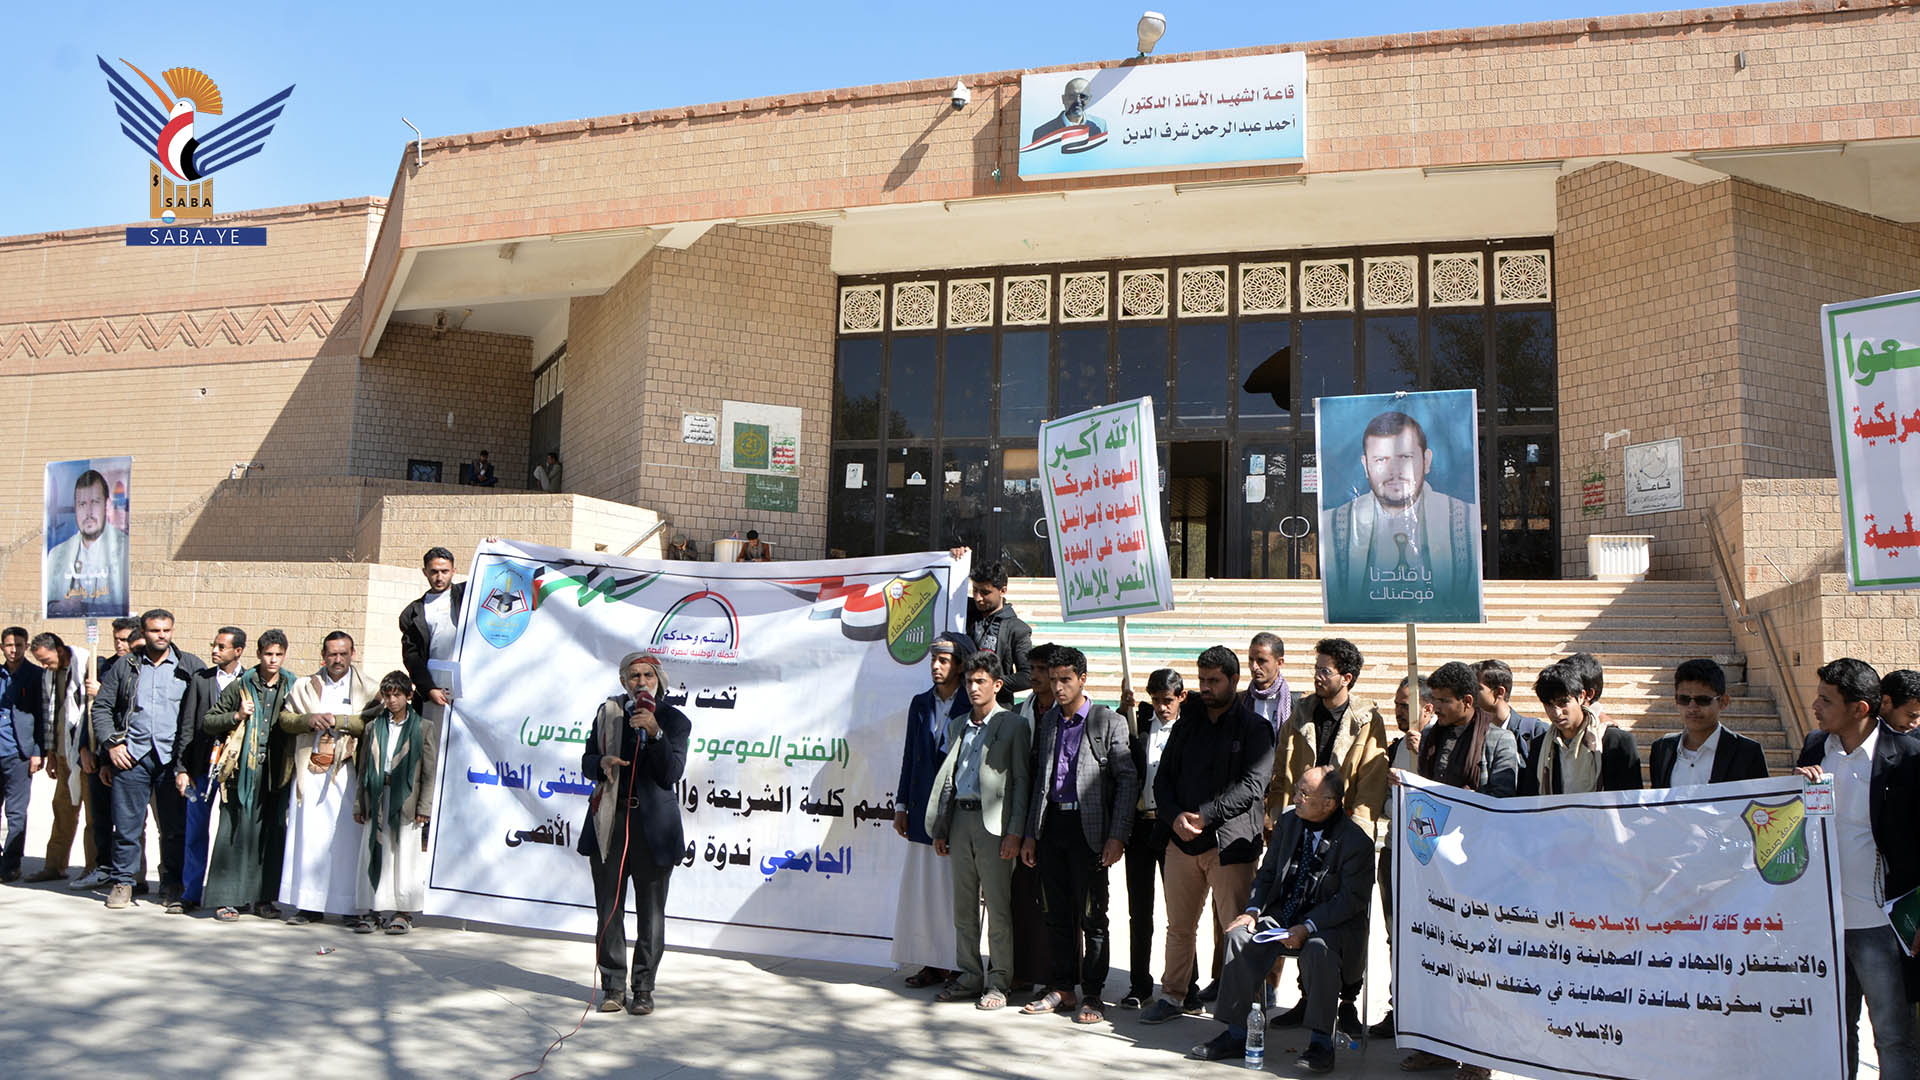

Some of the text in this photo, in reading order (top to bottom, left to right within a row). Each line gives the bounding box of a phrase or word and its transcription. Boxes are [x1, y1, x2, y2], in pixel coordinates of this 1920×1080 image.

[1175, 90, 1213, 108] الأستاذ
[1217, 88, 1259, 106] الشهيد
[1263, 84, 1295, 100] قاعة
[1122, 123, 1157, 145] الدين
[1161, 121, 1190, 140] شرف
[1264, 113, 1296, 131] أحمد
[1048, 417, 1102, 471] أكبر
[1052, 459, 1138, 498] الموت لأمريكا
[1636, 477, 1671, 492] قاعة
[1105, 493, 1142, 524] الموت
[1064, 537, 1094, 567] اليهود
[1117, 529, 1146, 553] اللعنة
[1114, 559, 1151, 601] النصر
[1420, 565, 1432, 585] يا
[1369, 586, 1435, 604] فوضناك
[660, 630, 729, 646] لستم وحدكم
[695, 685, 738, 710] تحت
[693, 735, 782, 764] الموعود
[466, 761, 532, 791] الطالب
[706, 779, 792, 818] الشريعة
[799, 786, 846, 823] كلية
[853, 792, 896, 829] قيم
[505, 813, 571, 849] الأقصى
[704, 835, 752, 871] ندوة
[759, 844, 852, 883] الجامعي
[1460, 900, 1489, 919] لجان
[1494, 904, 1540, 924] تشكيل
[1545, 910, 1565, 932] إلى
[1569, 911, 1640, 935] الإسلامية
[1645, 913, 1709, 934] الشعوب
[1712, 913, 1740, 931] كافة
[1742, 912, 1785, 934] ندعو
[1506, 939, 1572, 965] والأهداف
[1576, 945, 1643, 968] الصهاينة
[1647, 951, 1673, 968] ضد
[1678, 952, 1733, 976] والجهاد
[1737, 953, 1828, 978] والاستنفار
[1421, 953, 1813, 1023] التي سخرتها لمساندة الصهاينة في مختلف البلدان العربية
